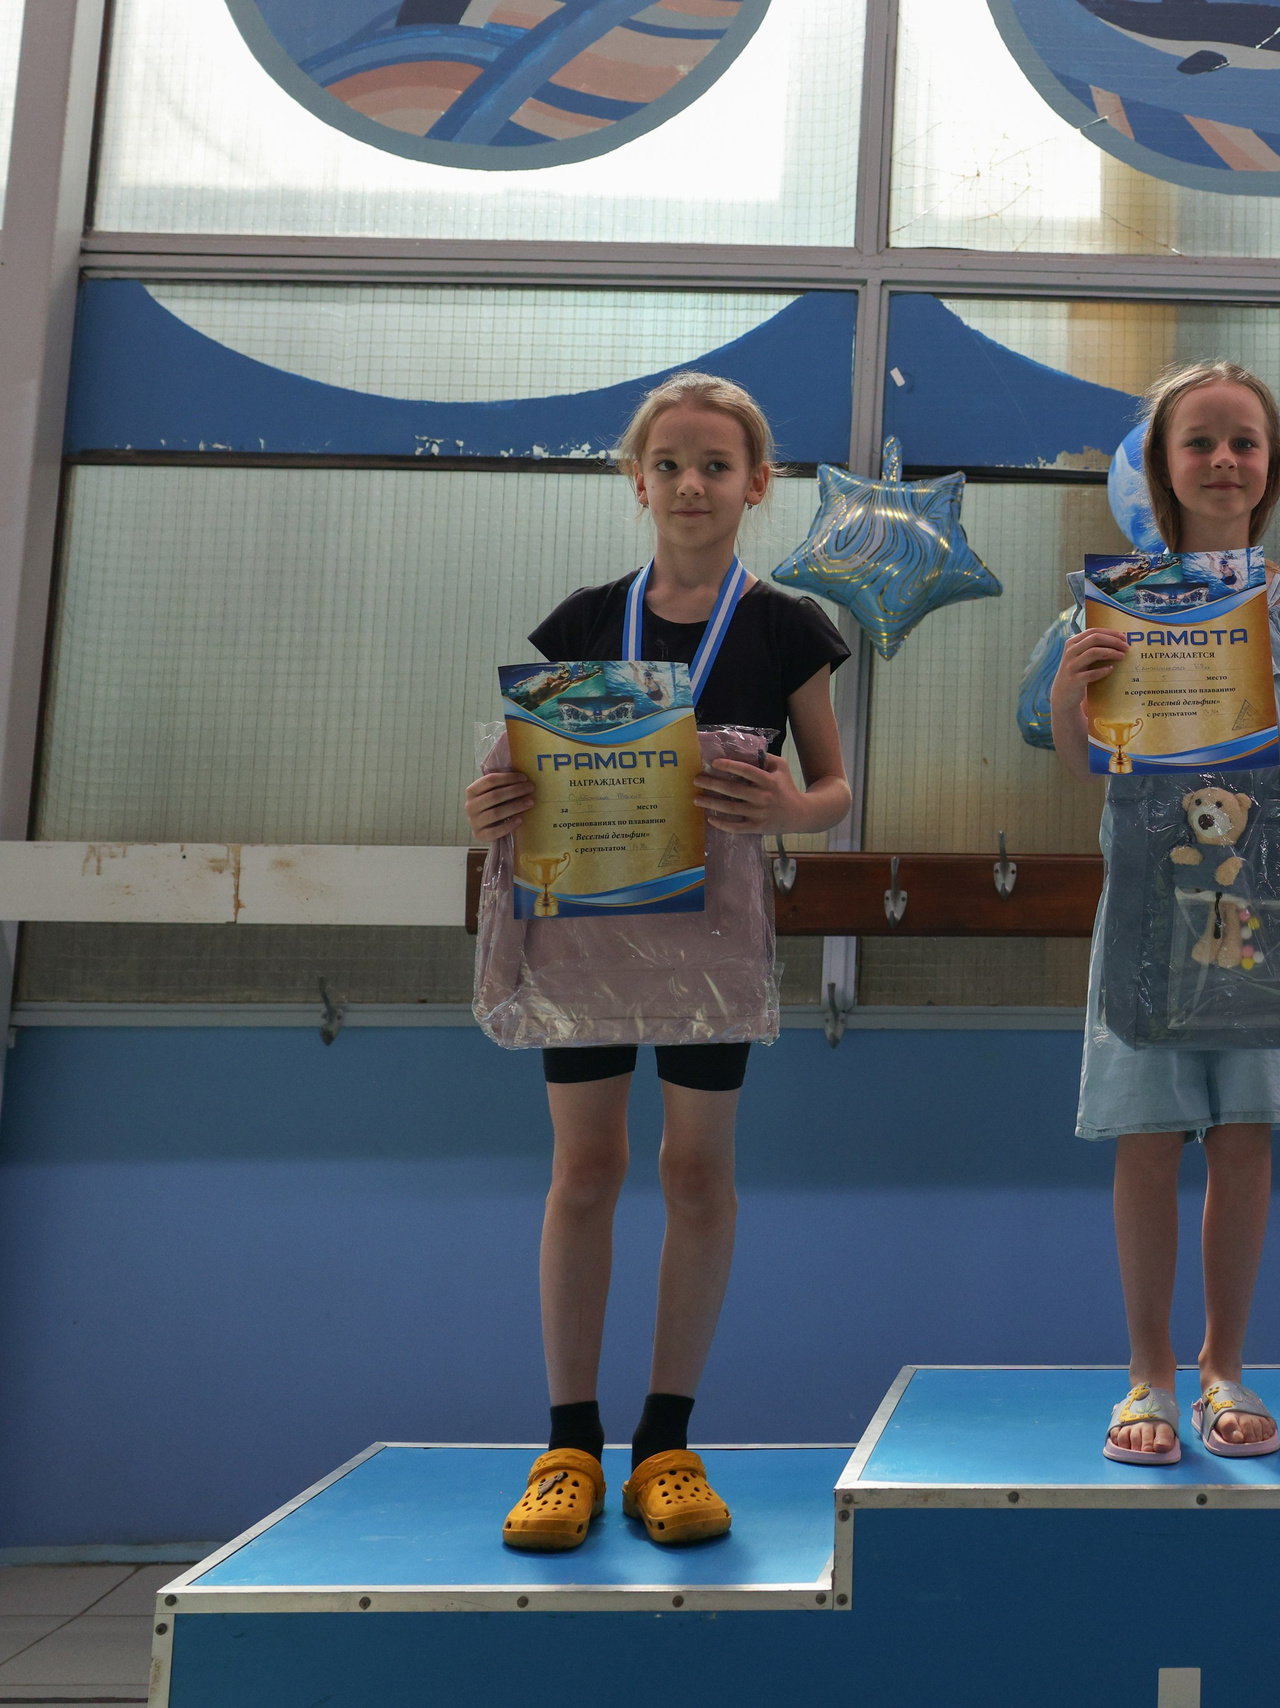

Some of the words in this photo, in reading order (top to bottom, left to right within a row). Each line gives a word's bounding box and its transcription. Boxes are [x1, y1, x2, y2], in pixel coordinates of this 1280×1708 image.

[1123, 629, 1247, 646] РАМОТА
[1131, 688, 1187, 696] соревнованиях
[1183, 698, 1220, 708] дельфин»
[1152, 710, 1197, 719] результатом
[537, 750, 678, 771] ГРАМОТА
[569, 777, 645, 787] НАГРАЖДАЕТСЯ
[558, 820, 616, 829] соревнованиях
[576, 832, 610, 841] Веселый
[611, 831, 650, 842] дельфин»
[580, 846, 626, 856] результатом
